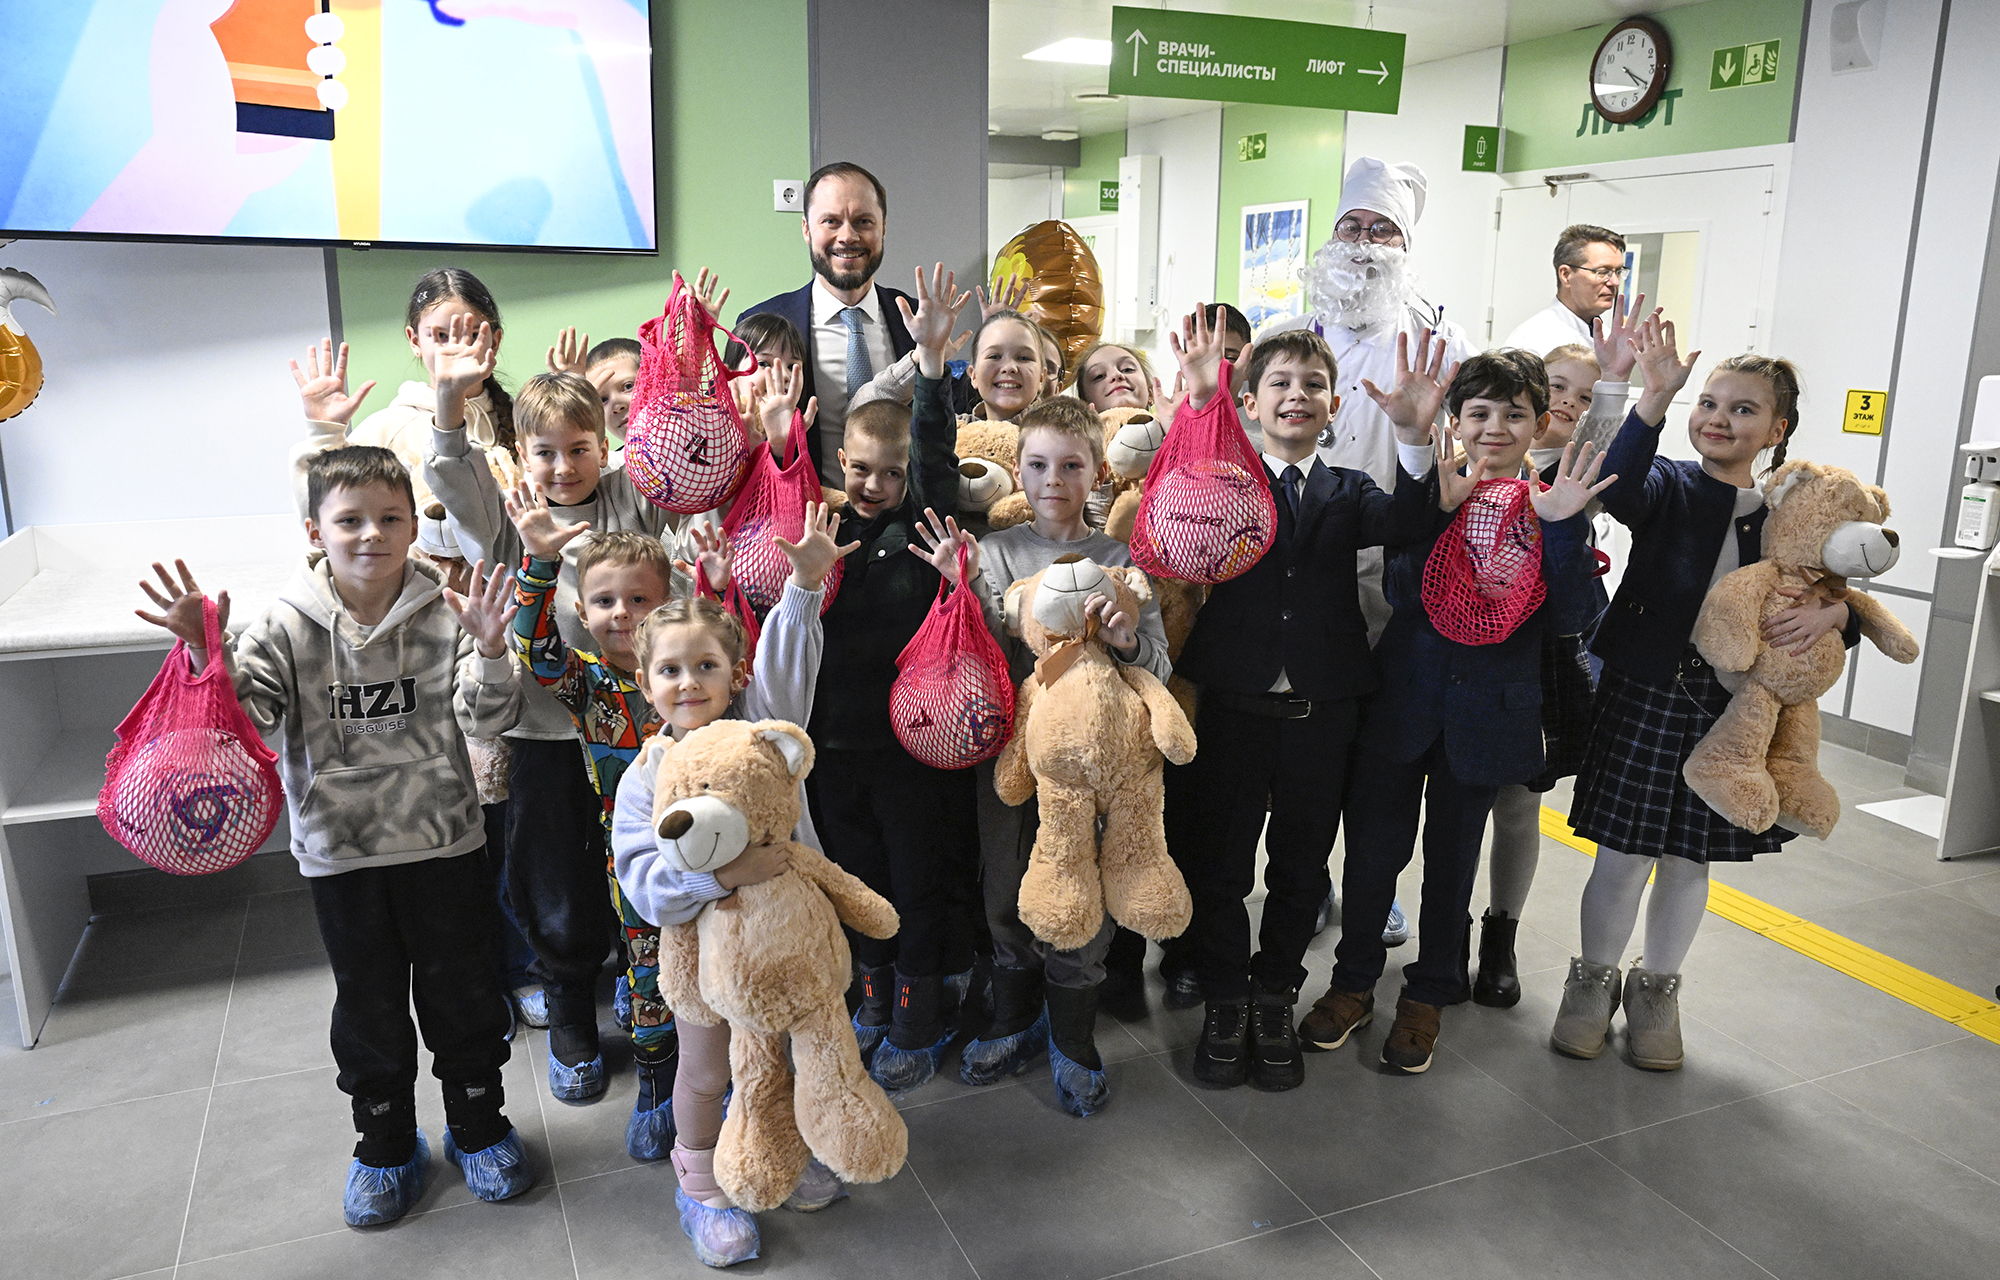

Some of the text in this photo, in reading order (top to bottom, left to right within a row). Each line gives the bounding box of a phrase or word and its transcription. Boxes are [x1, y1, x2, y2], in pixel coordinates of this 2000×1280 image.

[1627, 34, 1636, 45] 12
[1158, 41, 1216, 58] ВРАЧИ-
[1617, 41, 1624, 51] 11
[1607, 54, 1615, 64] 10
[1647, 48, 1654, 59] 2
[1157, 59, 1276, 81] СПЕЦИАЛИСТЫ
[1306, 59, 1346, 75] ЛИФТ
[1611, 95, 1617, 105] 7
[1621, 98, 1627, 107] 6
[1632, 93, 1639, 102] 5
[1860, 395, 1871, 411] 3
[1853, 413, 1874, 421] ЭТАЖ
[328, 677, 418, 720] HZJ
[345, 720, 406, 735] DISGUISE
